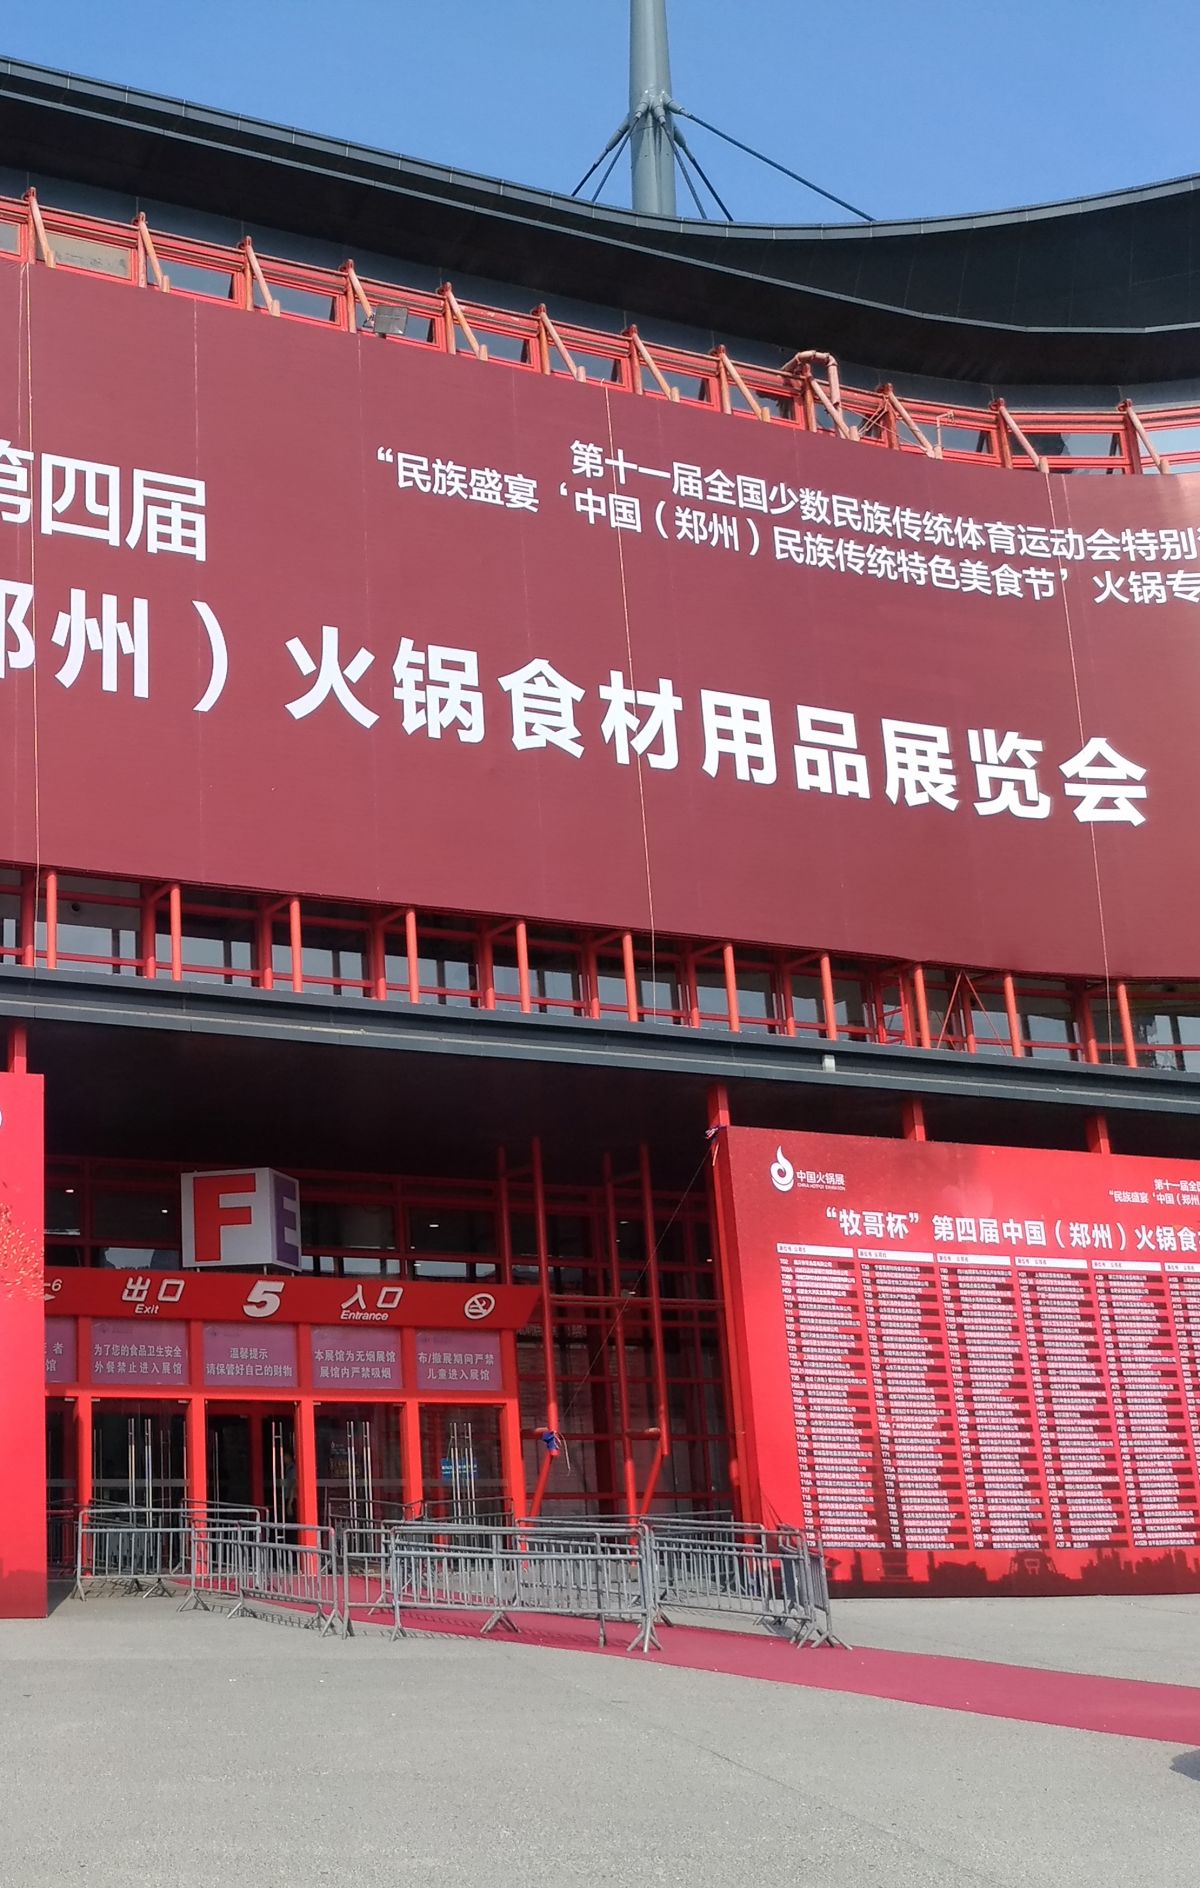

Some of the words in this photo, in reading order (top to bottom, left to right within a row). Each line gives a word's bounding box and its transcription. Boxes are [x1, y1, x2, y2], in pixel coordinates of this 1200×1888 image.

[570, 440, 1200, 561] 第十一届全国少数民族传统体育运动会特别
[796, 1169, 846, 1185] 中国火锅展
[1153, 1178, 1200, 1192] 第十一届全
[193, 1173, 257, 1262] F
[825, 1206, 920, 1240] “牧哥杯”
[931, 1214, 1200, 1251] 第四届中国（郑州）火锅食
[122, 1276, 185, 1302] 出口
[243, 1280, 285, 1318] 5
[341, 1284, 403, 1310] 入口
[135, 1304, 159, 1314] Exit
[340, 1310, 389, 1322] Entrance
[94, 1344, 182, 1358] 为了您的食品卫生安全
[230, 1347, 268, 1360] 温馨提示
[314, 1350, 396, 1363] 本展馆为无烟展馆
[94, 1360, 182, 1375] 外餐禁止进入展馆
[206, 1363, 293, 1377] 请保管好自己的财物
[319, 1366, 392, 1380] 展馆内严禁吸烟
[427, 1368, 490, 1381] 儿童进入展馆
